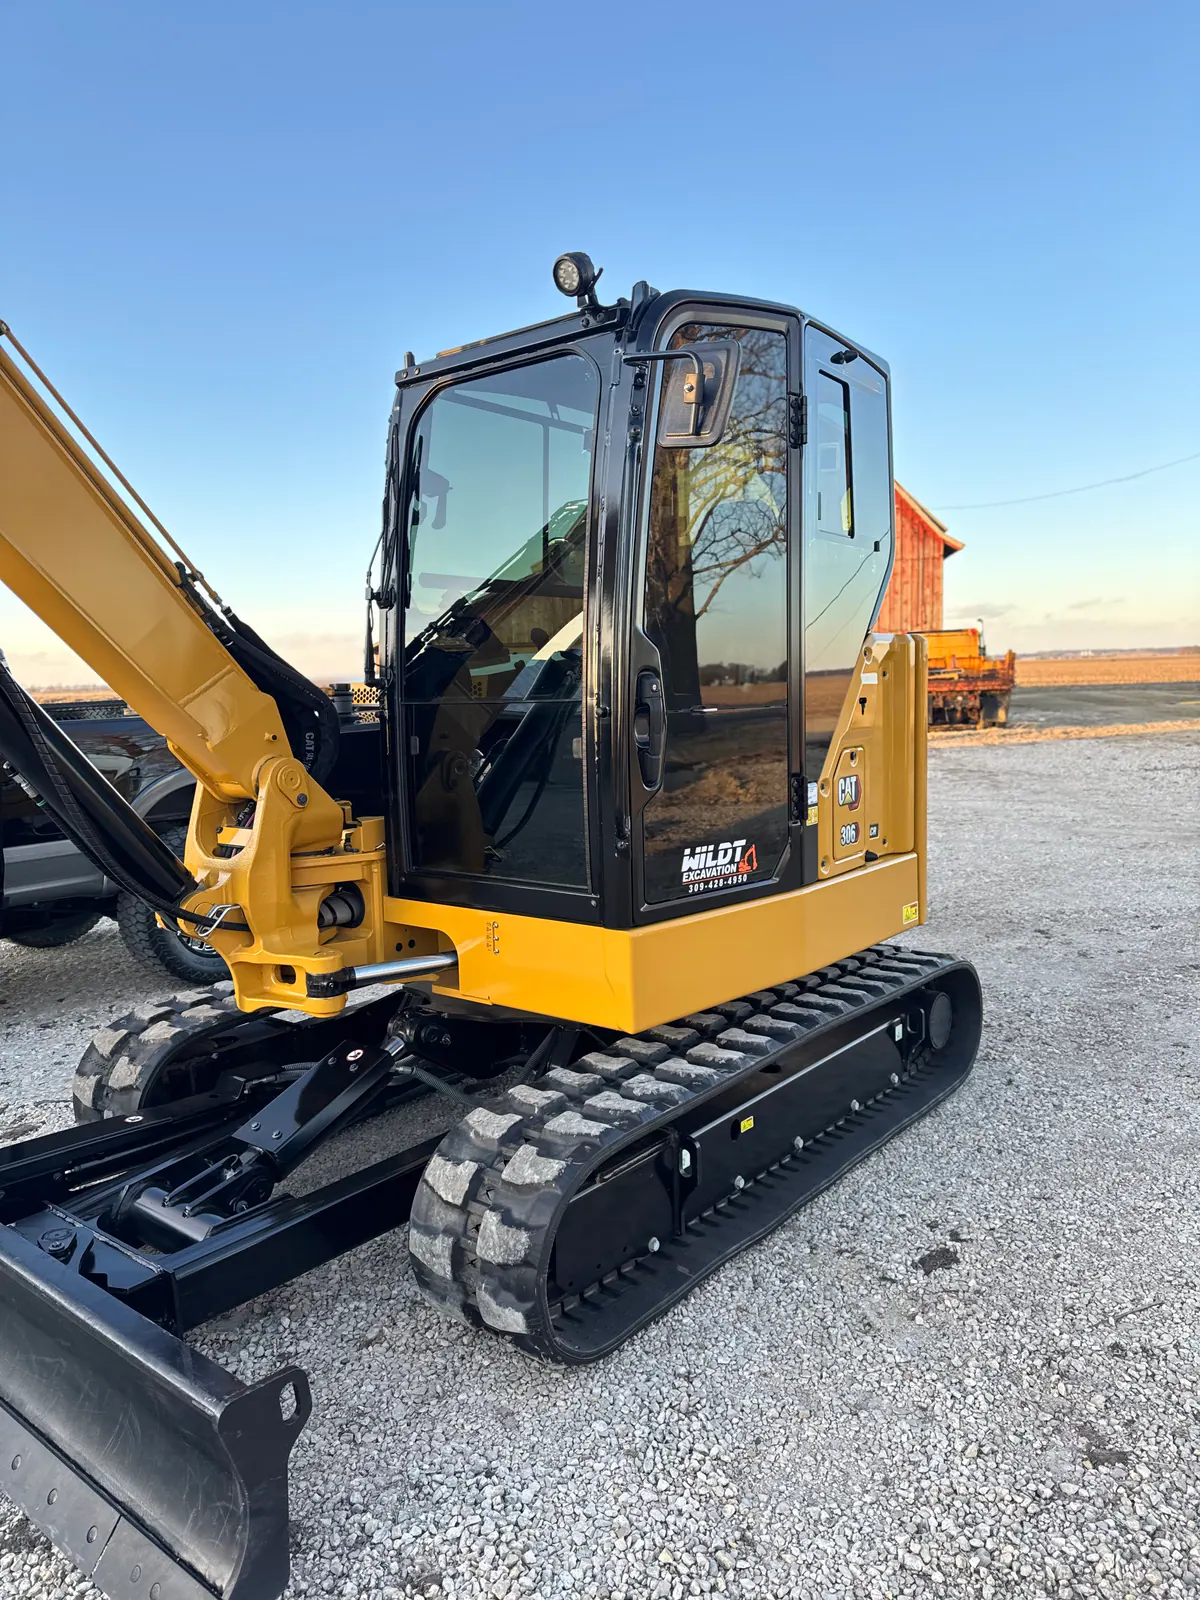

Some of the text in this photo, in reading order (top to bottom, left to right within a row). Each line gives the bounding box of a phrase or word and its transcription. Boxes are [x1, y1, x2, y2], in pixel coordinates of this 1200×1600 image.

[305, 732, 315, 751] CAT
[838, 776, 857, 806] CAT
[841, 823, 856, 845] 306
[681, 839, 747, 872] WILDT
[682, 863, 737, 883] EXCAVATION
[688, 873, 748, 893] 309-428-4950
